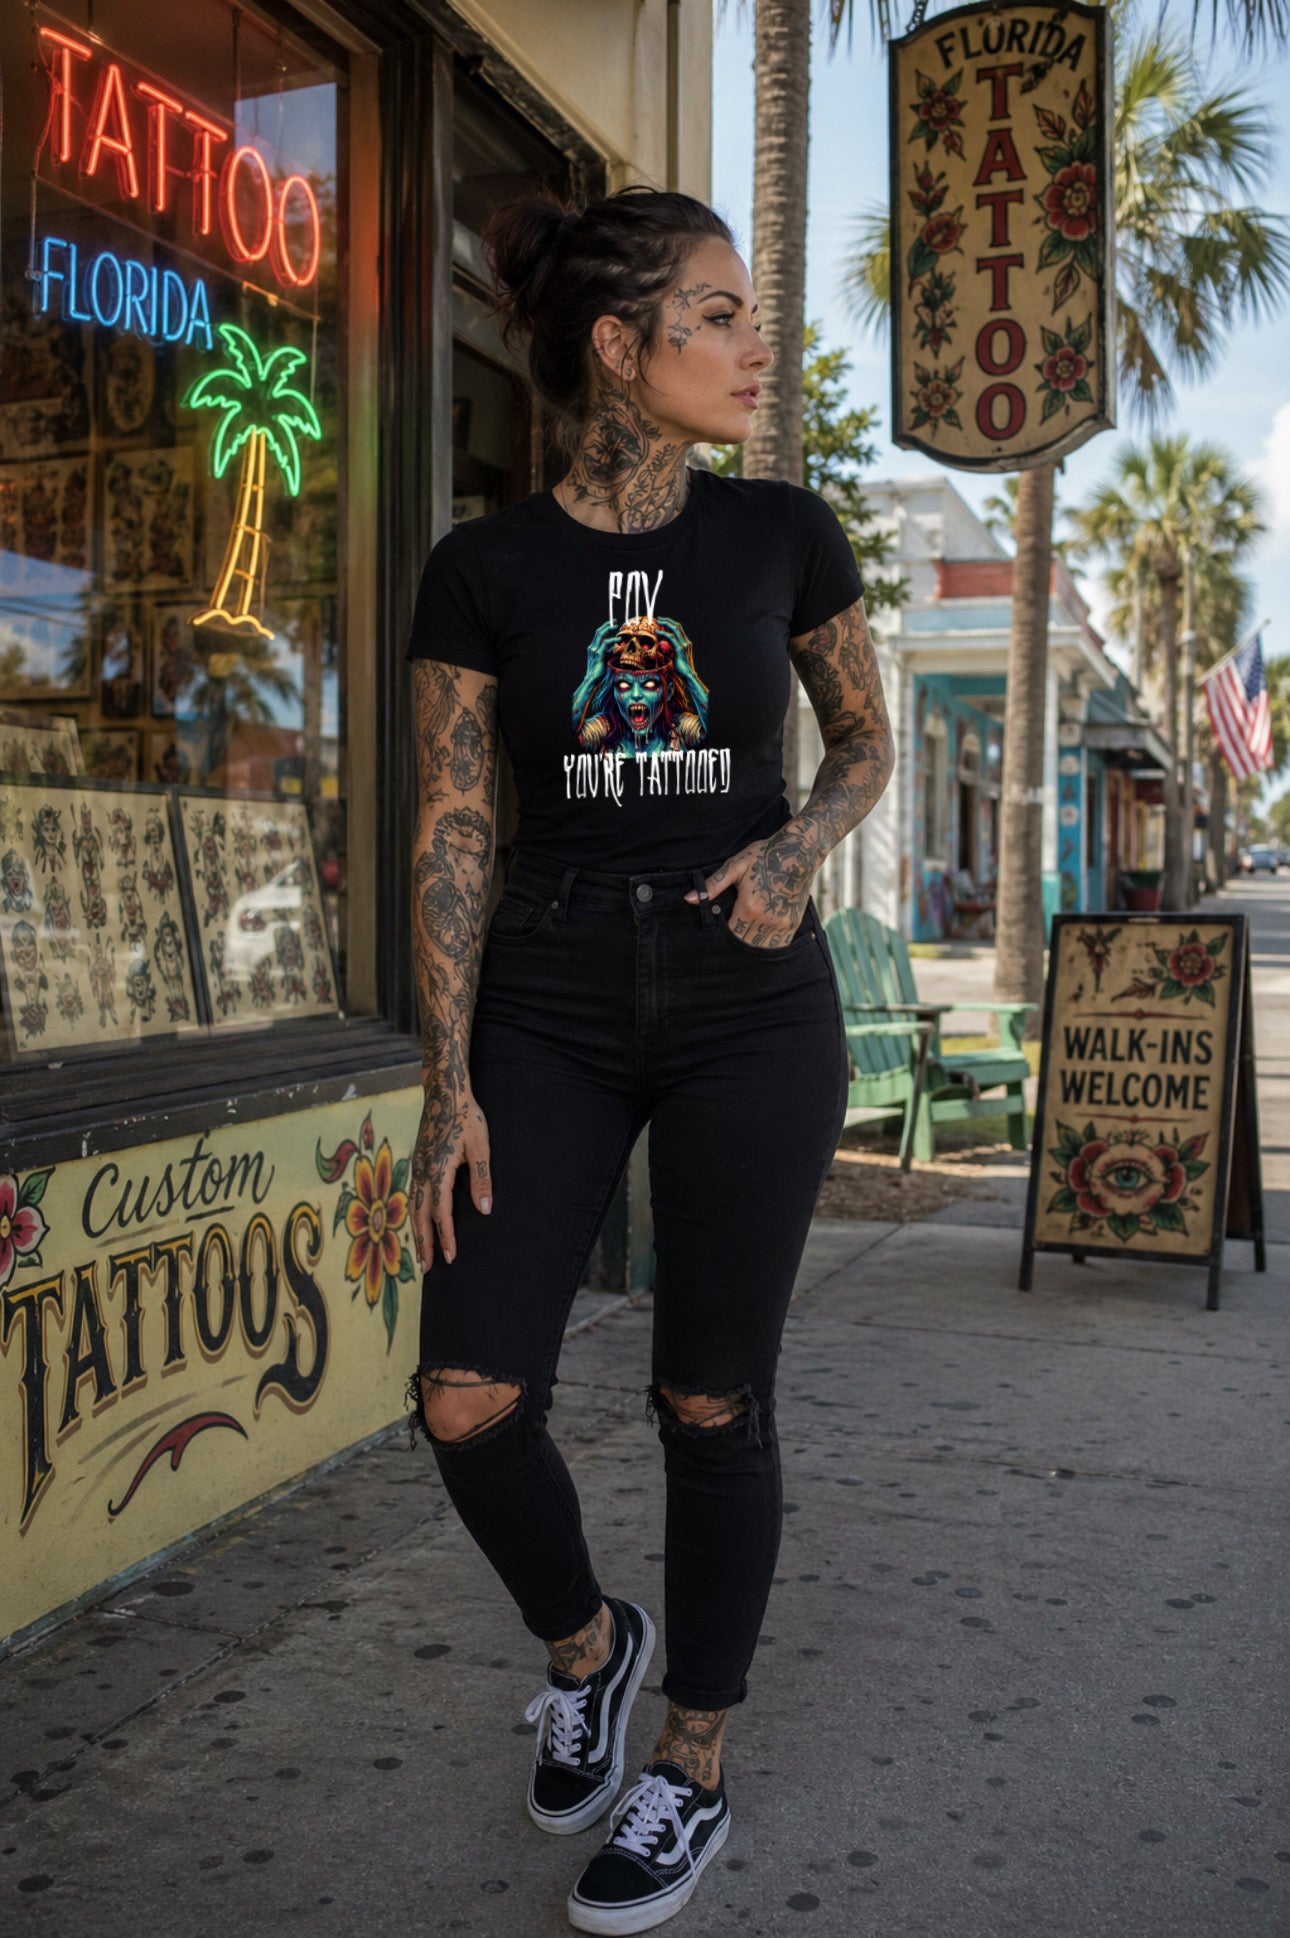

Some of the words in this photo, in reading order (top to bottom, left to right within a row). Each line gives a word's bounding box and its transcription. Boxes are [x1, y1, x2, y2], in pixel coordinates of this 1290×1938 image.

[934, 17, 1088, 72] FLORIDA
[39, 26, 321, 287] TATTOO
[40, 235, 214, 350] FLORIDA
[973, 63, 1027, 441] TATTOO
[563, 752, 625, 807] YOU'RE
[635, 748, 731, 796] TATTOOED
[1060, 1069, 1210, 1111] WELCOME
[1063, 1026, 1213, 1065] WALK-INS
[81, 1132, 275, 1239] Custom
[0, 1200, 331, 1538] TATTOOS
